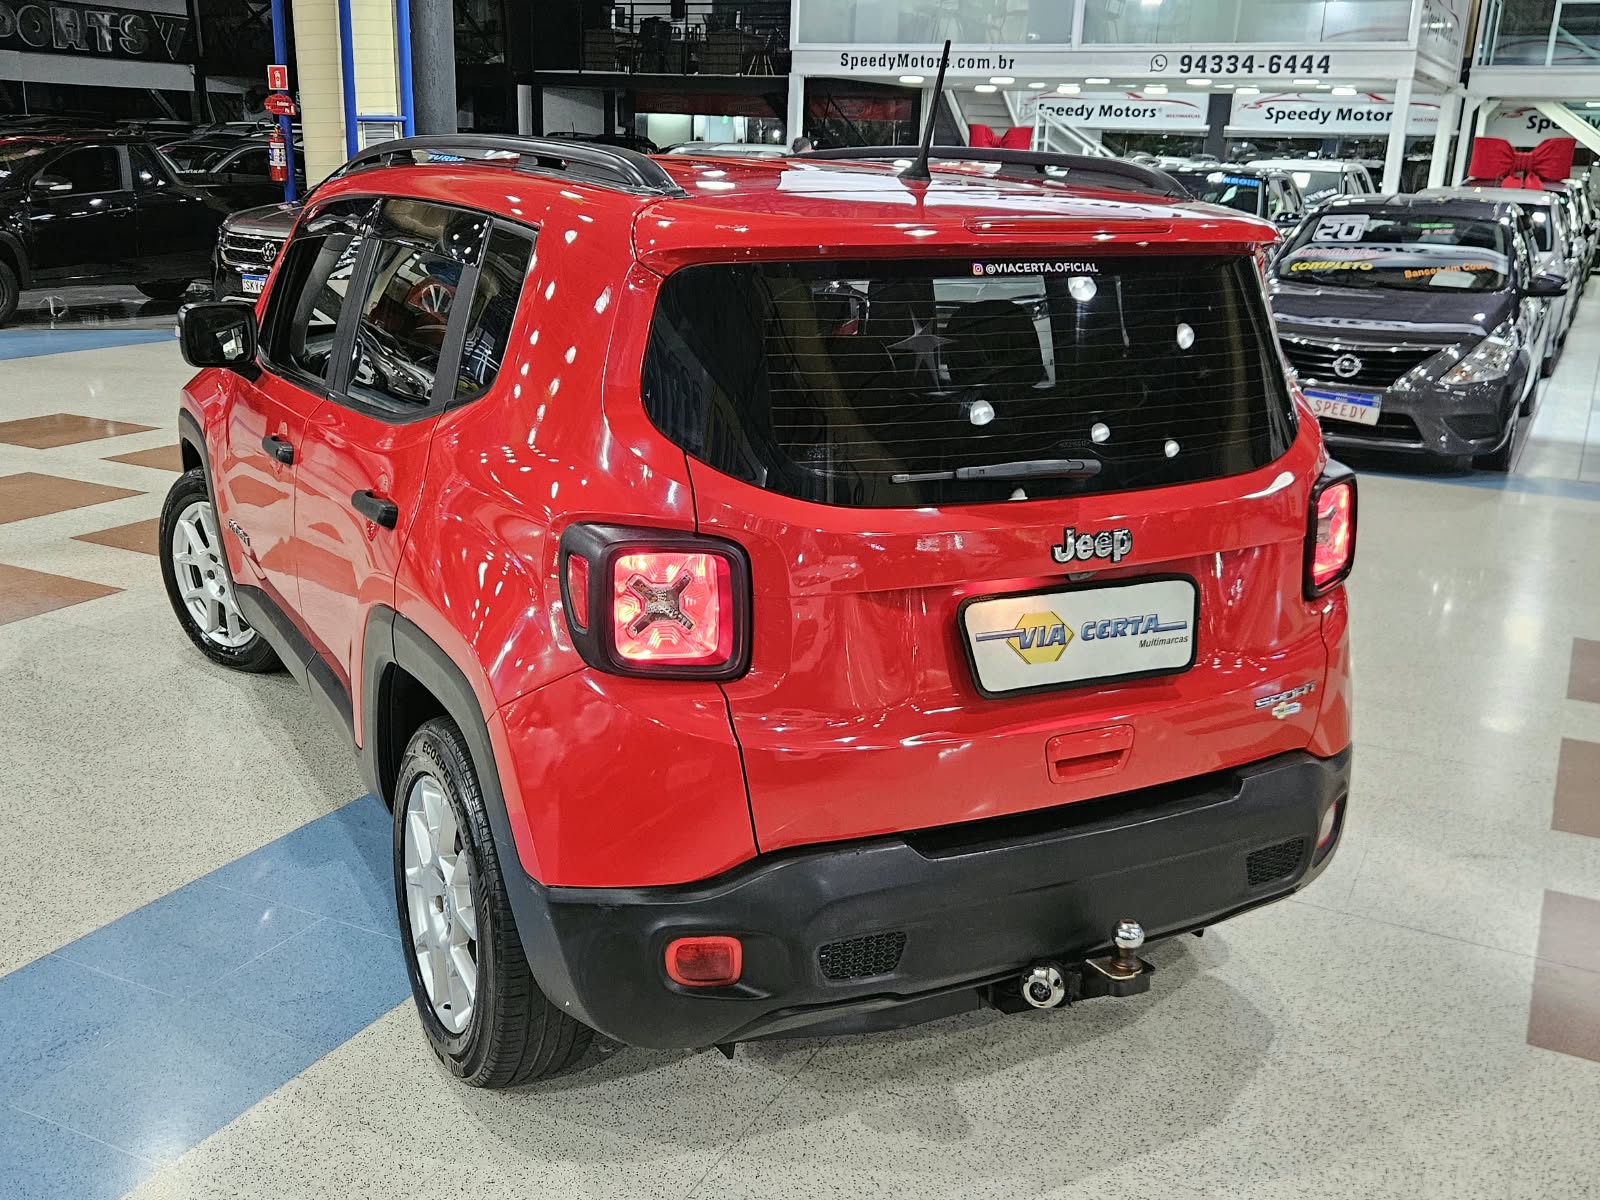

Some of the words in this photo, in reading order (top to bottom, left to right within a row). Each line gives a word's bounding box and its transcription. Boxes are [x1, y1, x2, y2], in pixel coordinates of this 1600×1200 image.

[1179, 54, 1330, 74] 94334-6444
[1099, 105, 1157, 118] Motors
[1265, 107, 1331, 125] Speedy
[1336, 108, 1393, 122] Motor
[985, 262, 1099, 275] @VIACERTA.OFICIAL
[1313, 399, 1367, 420] SPEEDY
[1052, 526, 1132, 564] Jeep
[1017, 623, 1068, 650] VIA
[1081, 614, 1159, 641] CERTA
[1138, 634, 1189, 649] Multimarcas
